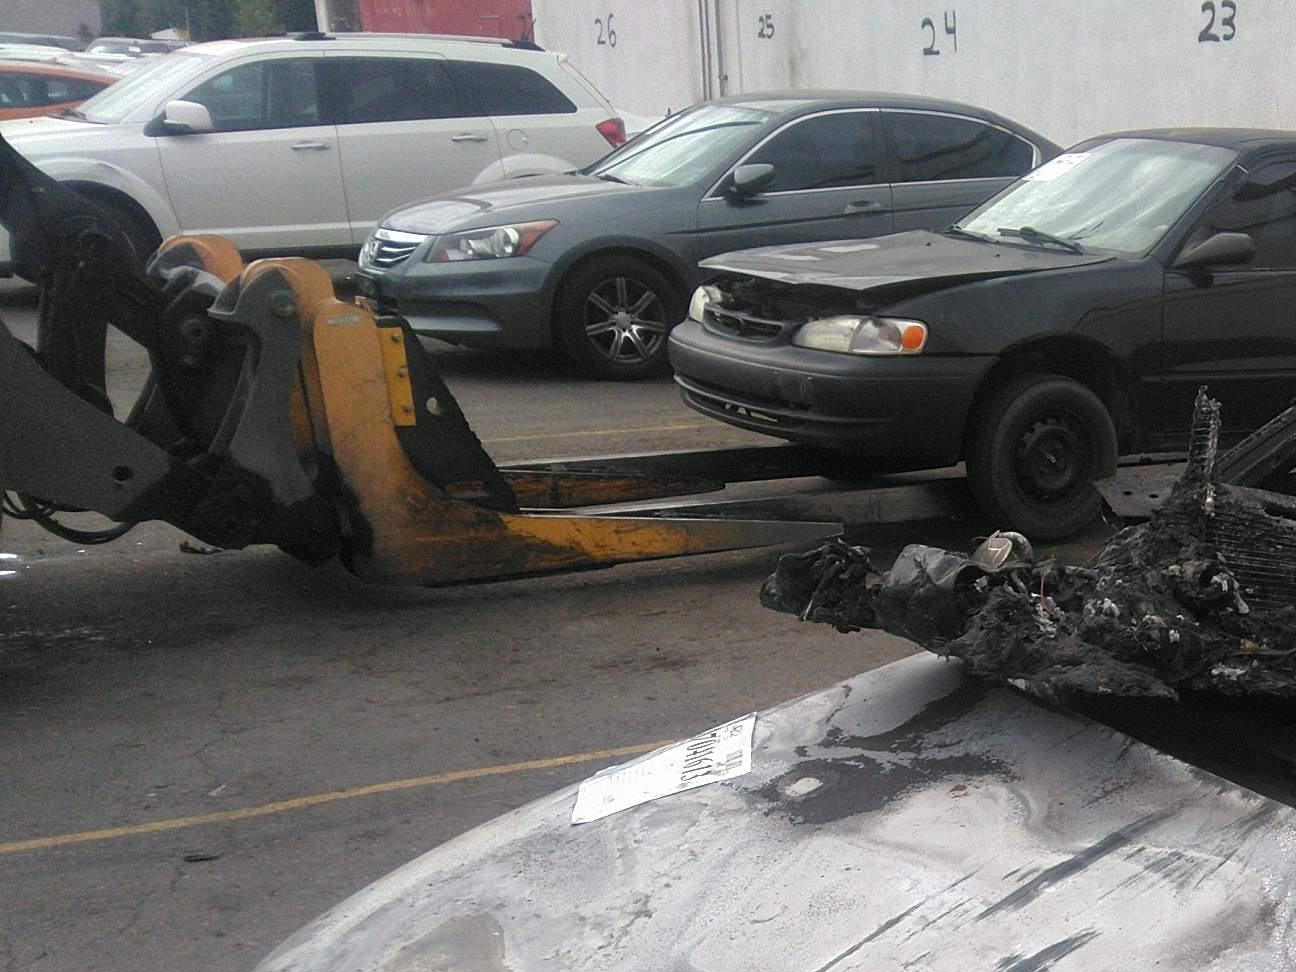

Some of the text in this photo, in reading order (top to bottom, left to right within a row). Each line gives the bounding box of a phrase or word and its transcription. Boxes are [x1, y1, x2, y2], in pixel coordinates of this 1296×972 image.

[595, 13, 617, 48] 26
[758, 14, 774, 39] 25
[921, 9, 957, 56] 24
[1198, 0, 1236, 43] 23
